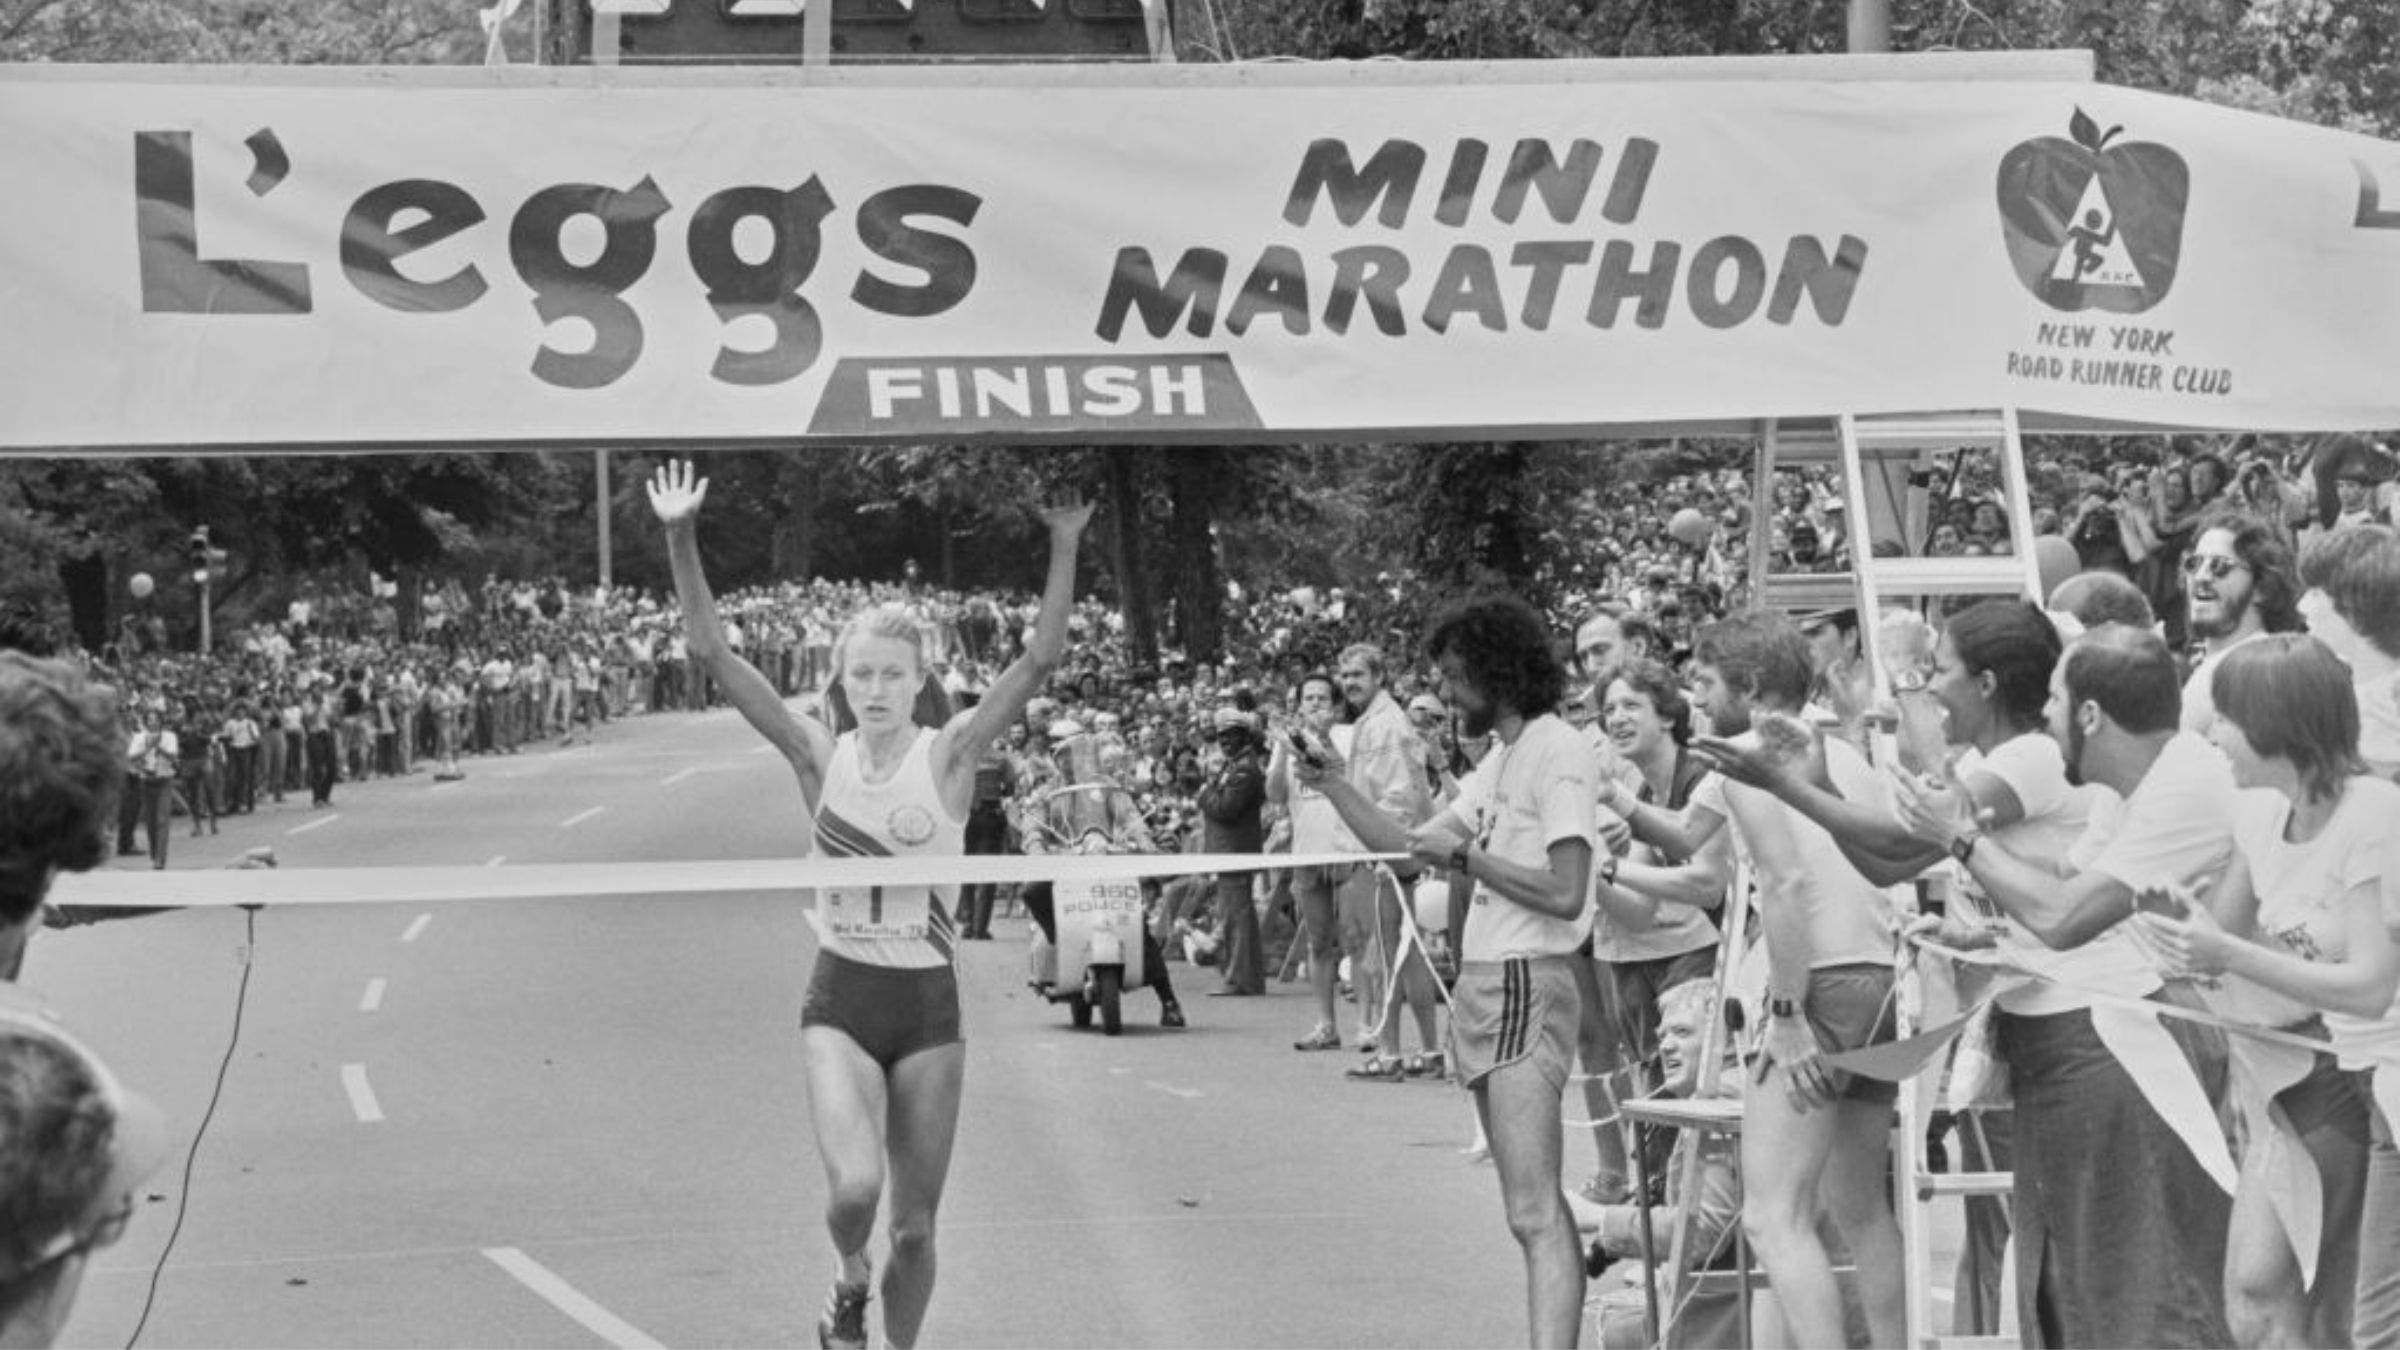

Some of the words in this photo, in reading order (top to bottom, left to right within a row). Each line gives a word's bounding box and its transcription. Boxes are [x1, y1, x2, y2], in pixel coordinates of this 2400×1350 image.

[1282, 137, 1660, 230] MINI
[134, 127, 984, 389] L'eggs
[1095, 234, 1868, 344] MARATHON
[2006, 350, 2064, 381] ROAD
[2070, 358, 2163, 391] RUNNER
[2172, 365, 2232, 396] CLUB
[2036, 322, 2096, 348] NEW
[2109, 326, 2175, 357] YORK
[867, 365, 1206, 418] FINISH
